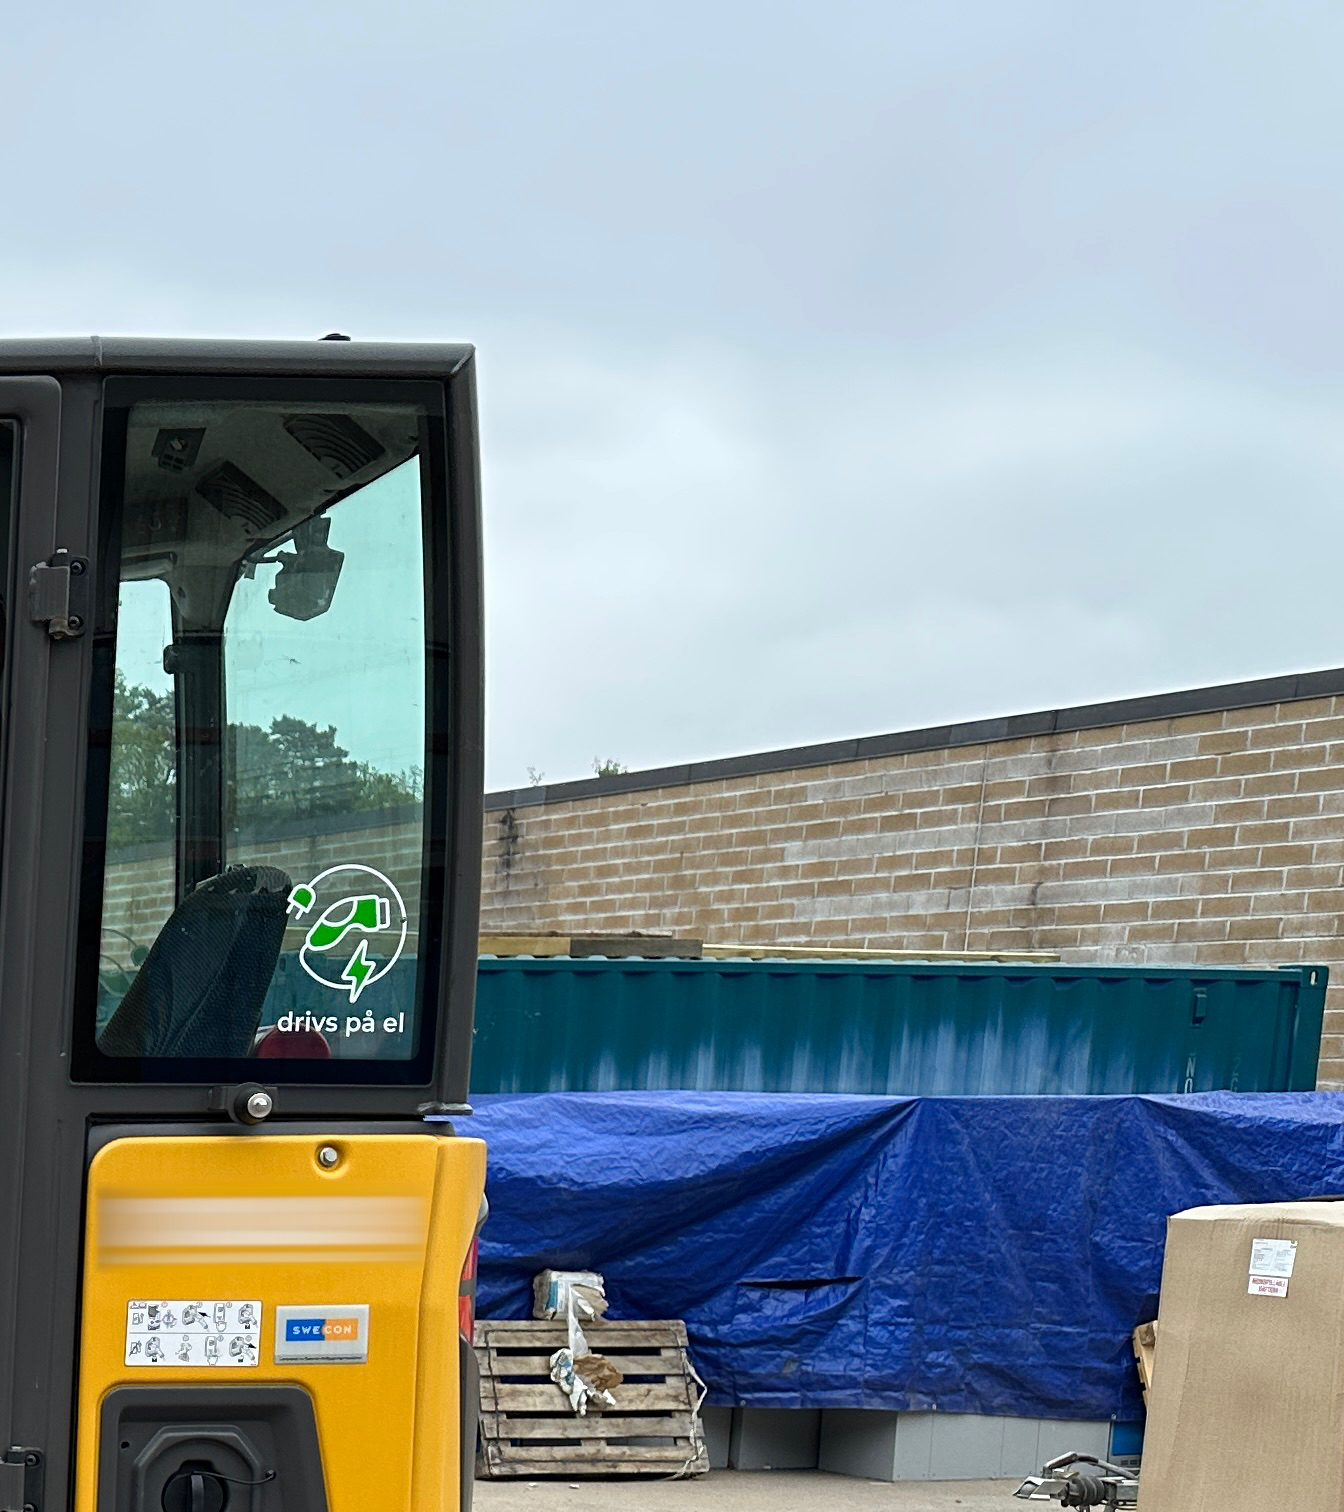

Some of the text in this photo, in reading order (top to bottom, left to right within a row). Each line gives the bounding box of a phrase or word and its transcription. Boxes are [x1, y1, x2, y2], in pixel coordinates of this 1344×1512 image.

[276, 1009, 406, 1038] drivs på el
[292, 1324, 353, 1335] SWECON
